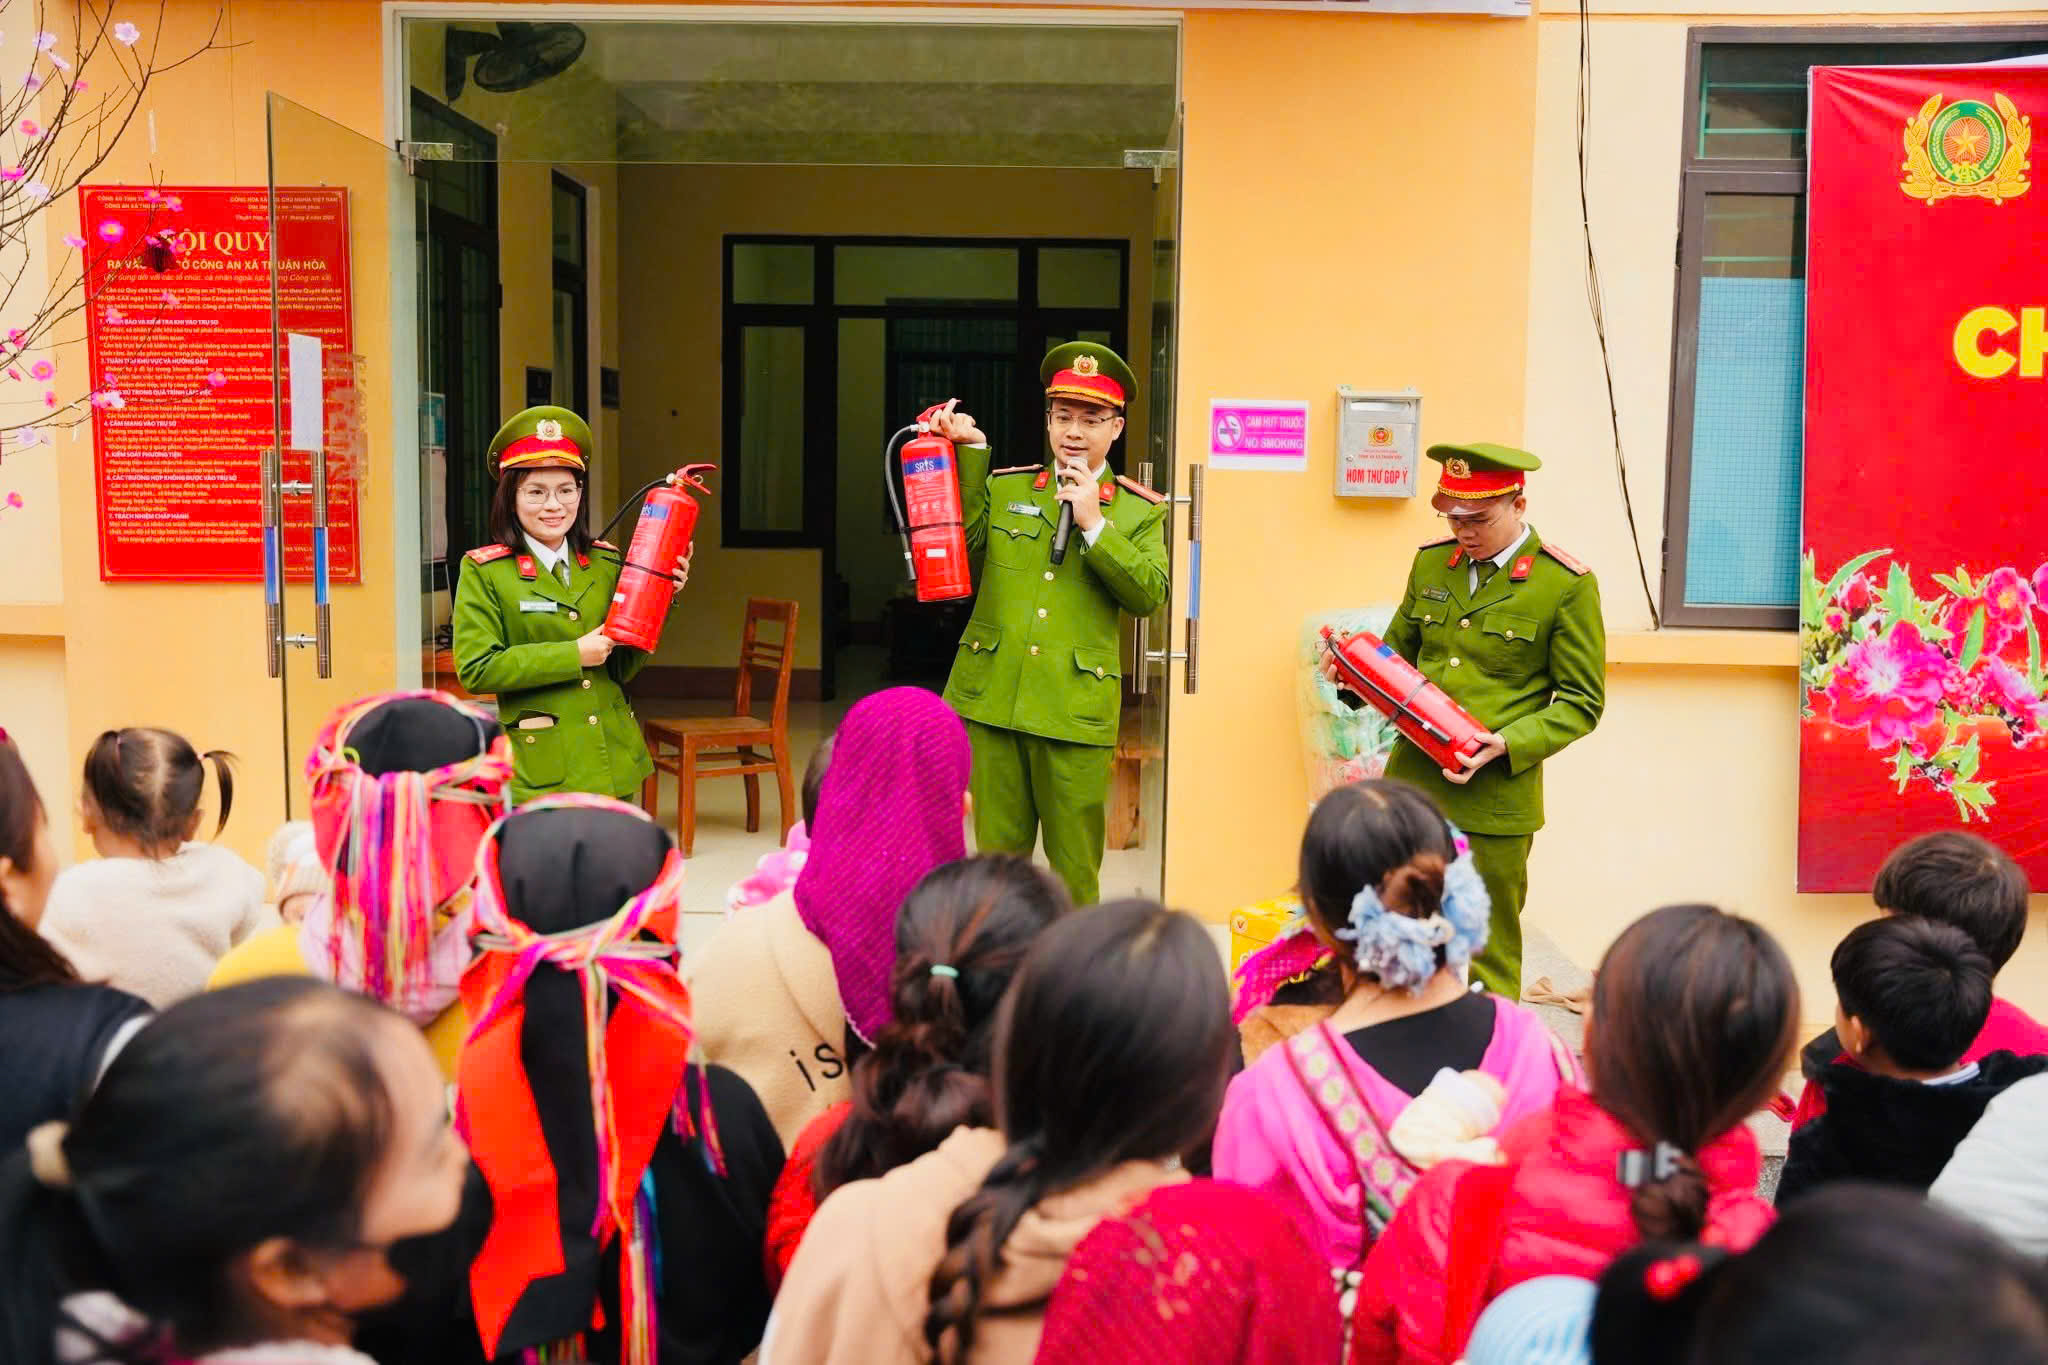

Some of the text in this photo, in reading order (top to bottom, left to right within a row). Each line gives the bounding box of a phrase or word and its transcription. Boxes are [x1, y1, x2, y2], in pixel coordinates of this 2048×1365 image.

[192, 257, 224, 270] CÔNG
[226, 261, 241, 270] AN
[1245, 437, 1304, 449] NO SMOKING
